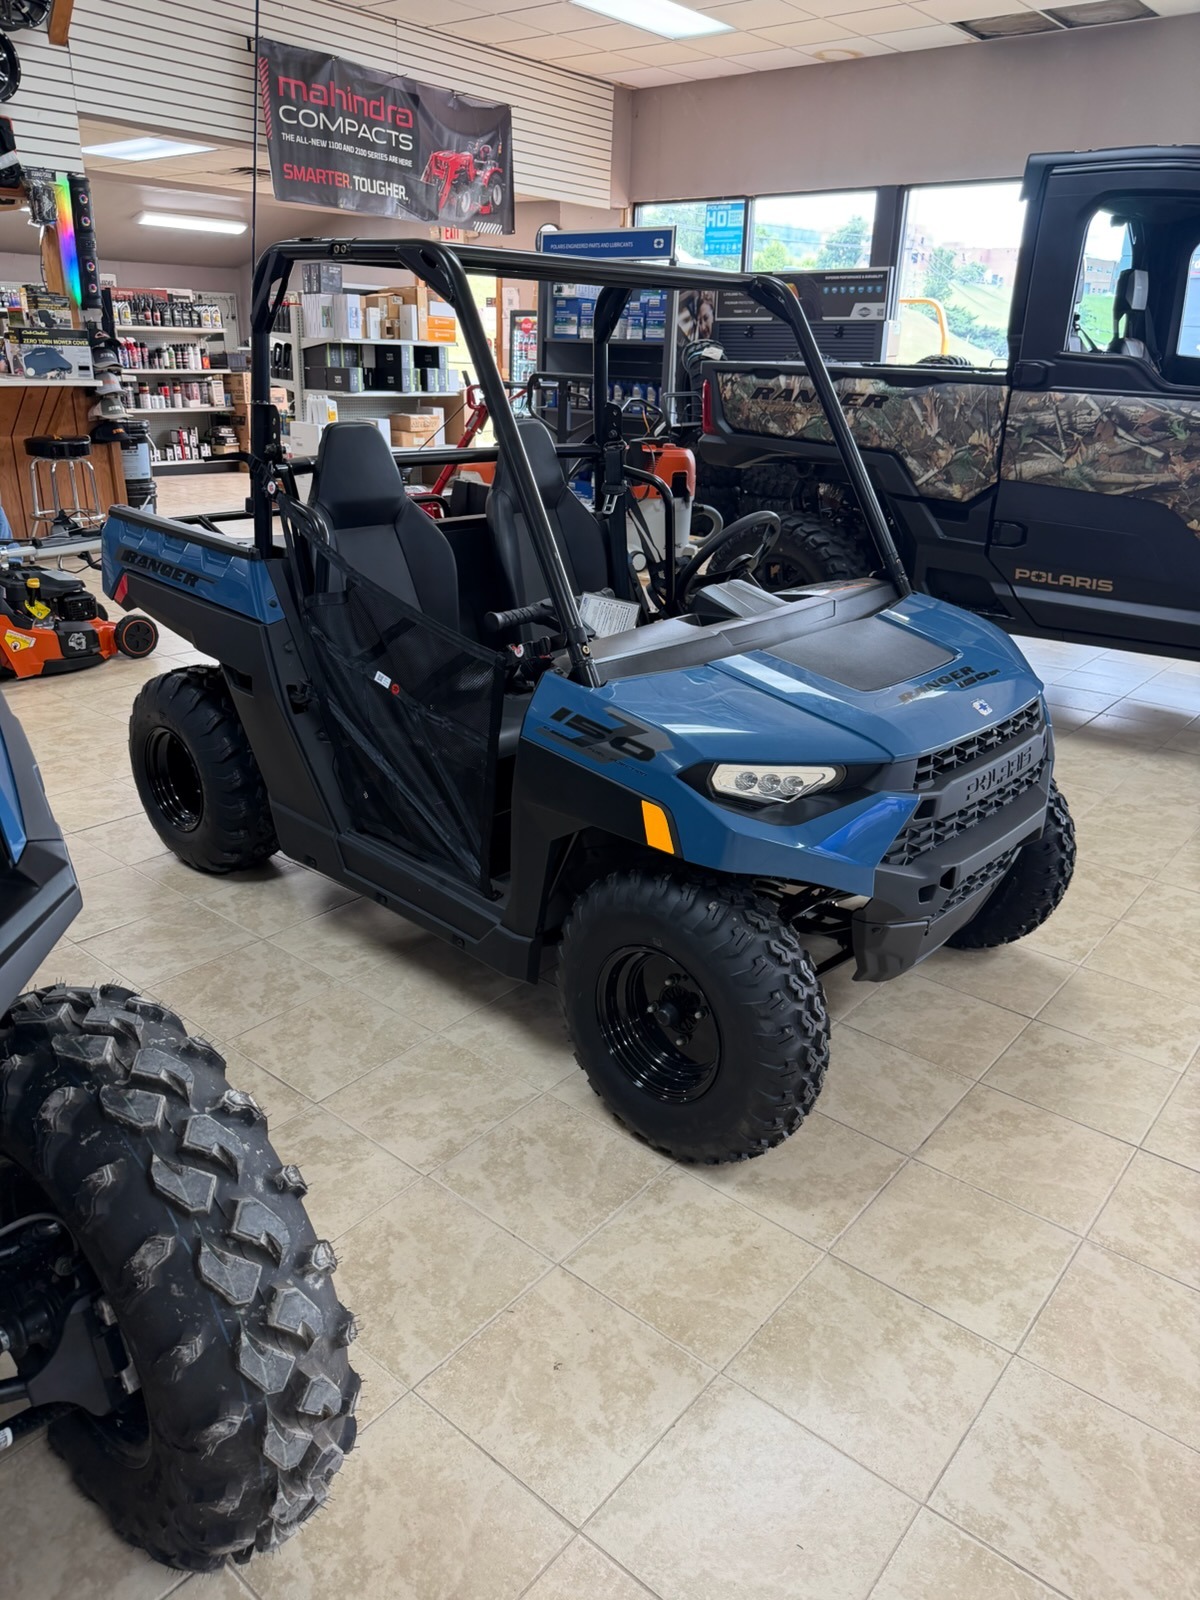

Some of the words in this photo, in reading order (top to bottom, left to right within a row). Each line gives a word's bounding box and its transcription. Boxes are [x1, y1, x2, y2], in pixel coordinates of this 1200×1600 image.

[277, 76, 414, 129] mahindra
[279, 105, 413, 151] COMPACTS
[281, 132, 295, 143] THE
[295, 135, 328, 148] ALL-NEW
[328, 140, 343, 150] 1100
[343, 144, 355, 154] AND
[367, 150, 388, 161] SERIES
[388, 155, 398, 164] ARE
[398, 158, 413, 167] HERE
[283, 163, 353, 190] SMARTER.
[352, 175, 409, 200] TOUGHER.
[706, 210, 729, 228] HD
[750, 387, 889, 409] RANER
[122, 549, 200, 588] RANGER
[1014, 568, 1113, 592] POLARIS
[898, 666, 977, 703] RANGER
[965, 746, 1032, 802] POLARIS
